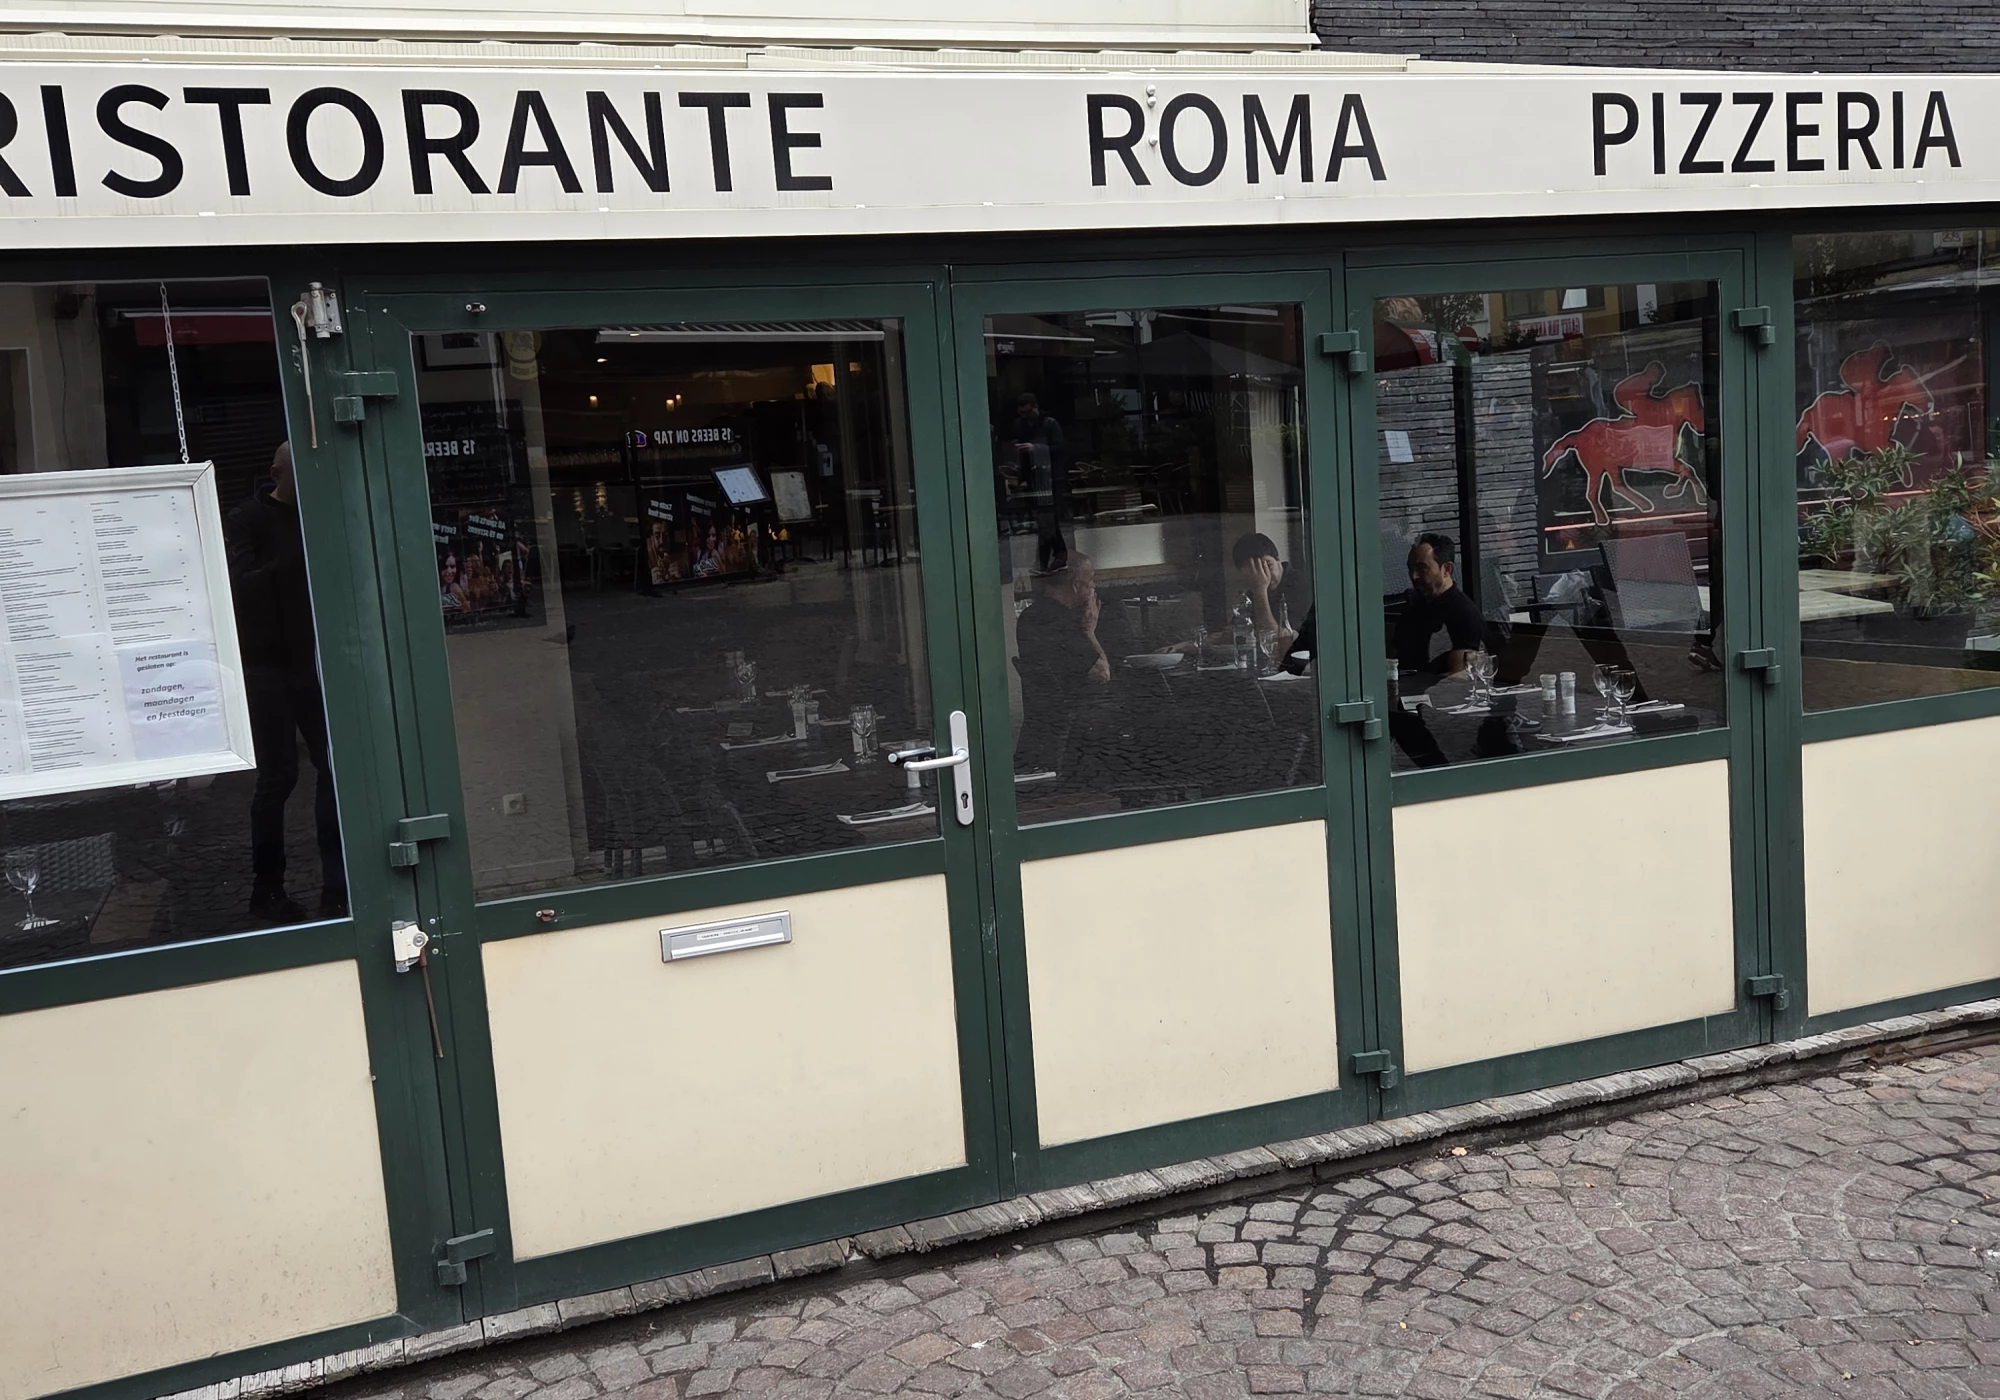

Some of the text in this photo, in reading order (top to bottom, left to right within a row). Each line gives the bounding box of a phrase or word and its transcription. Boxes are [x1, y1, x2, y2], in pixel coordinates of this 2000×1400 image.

[1086, 93, 1387, 187] ROMA
[1592, 91, 1961, 176] PIZZERIA
[135, 655, 147, 663] Het
[148, 651, 182, 661] restaurant
[136, 662, 165, 673] gesloten
[141, 683, 186, 694] zondagen,
[143, 695, 195, 708] maandagen
[158, 707, 206, 721] feestdagen
